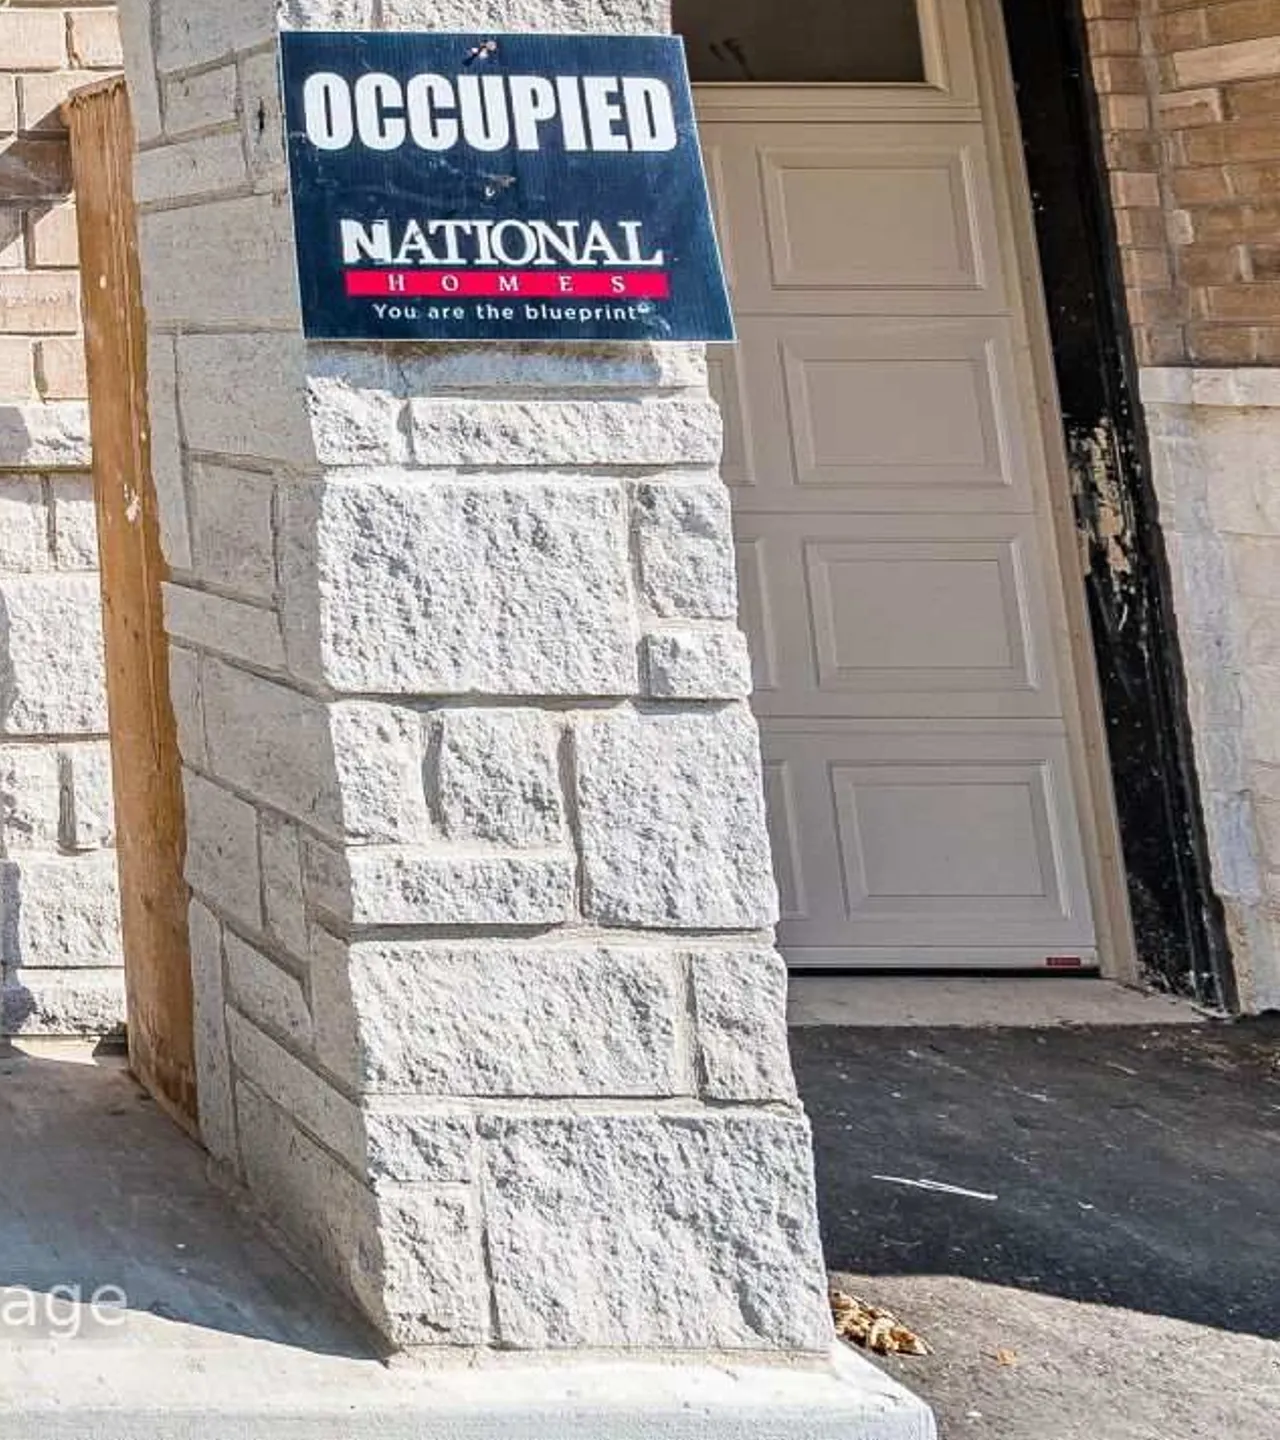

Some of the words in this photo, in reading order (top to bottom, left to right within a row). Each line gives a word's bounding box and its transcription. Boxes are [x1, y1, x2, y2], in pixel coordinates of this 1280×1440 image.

[302, 71, 678, 152] OCCUPIED
[340, 218, 664, 265] NATIONAL
[388, 273, 627, 292] HOMES
[372, 303, 416, 320] You
[428, 305, 465, 320] are
[476, 303, 514, 320] the
